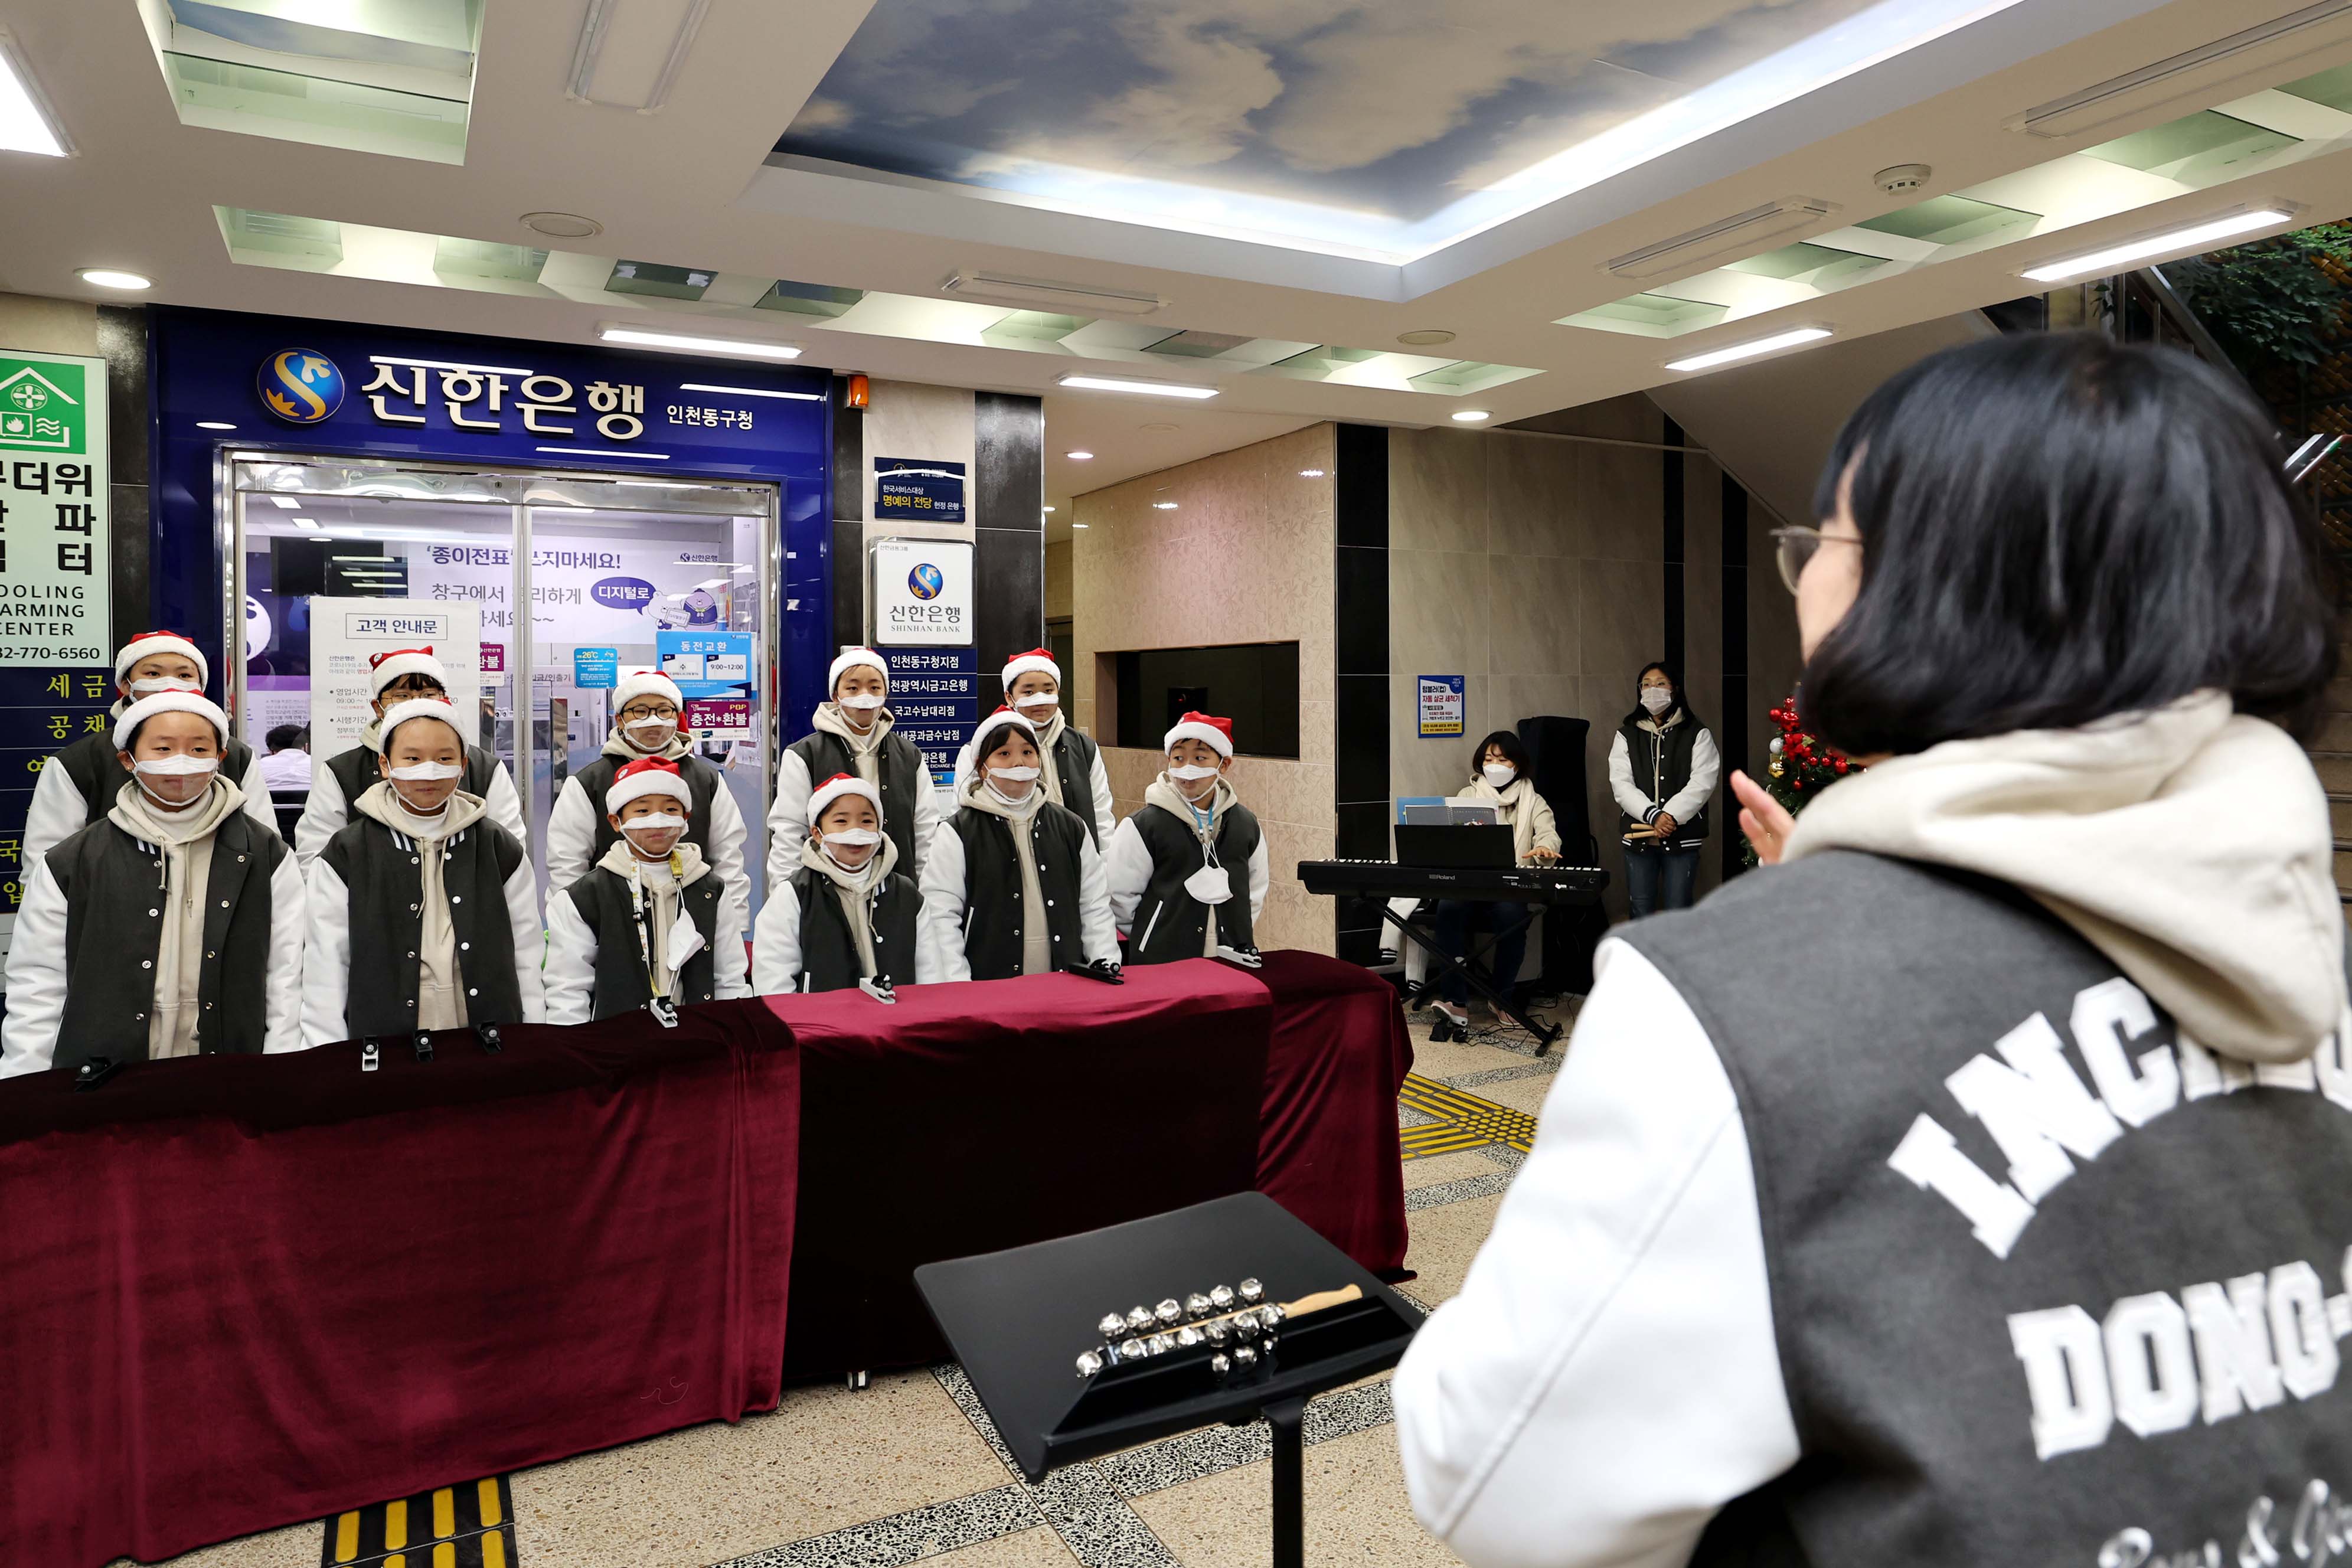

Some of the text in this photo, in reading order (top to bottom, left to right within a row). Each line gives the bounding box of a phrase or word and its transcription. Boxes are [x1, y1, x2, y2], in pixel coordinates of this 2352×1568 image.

[361, 363, 645, 440] 신한은행
[666, 404, 753, 432] 인천동구청
[0, 460, 92, 497] 더위
[883, 484, 924, 495] 한국서비스대상
[883, 495, 911, 508] 명예의
[913, 496, 932, 509] 전당
[947, 502, 959, 511] 은행
[432, 583, 651, 605] 창구에서 리하게 디지털로
[889, 605, 961, 623] 신한은행
[0, 622, 74, 636] ENTER
[356, 619, 437, 633] 고객 안내문
[0, 646, 100, 660] 2-770-6560
[681, 641, 727, 652] 동전교환
[891, 655, 959, 669] 인천동구청지점
[336, 688, 367, 696] 영업시간
[888, 679, 968, 692] 천광역시금고은행
[894, 705, 955, 717] 국고수납대리점
[336, 716, 367, 724] 시행기간
